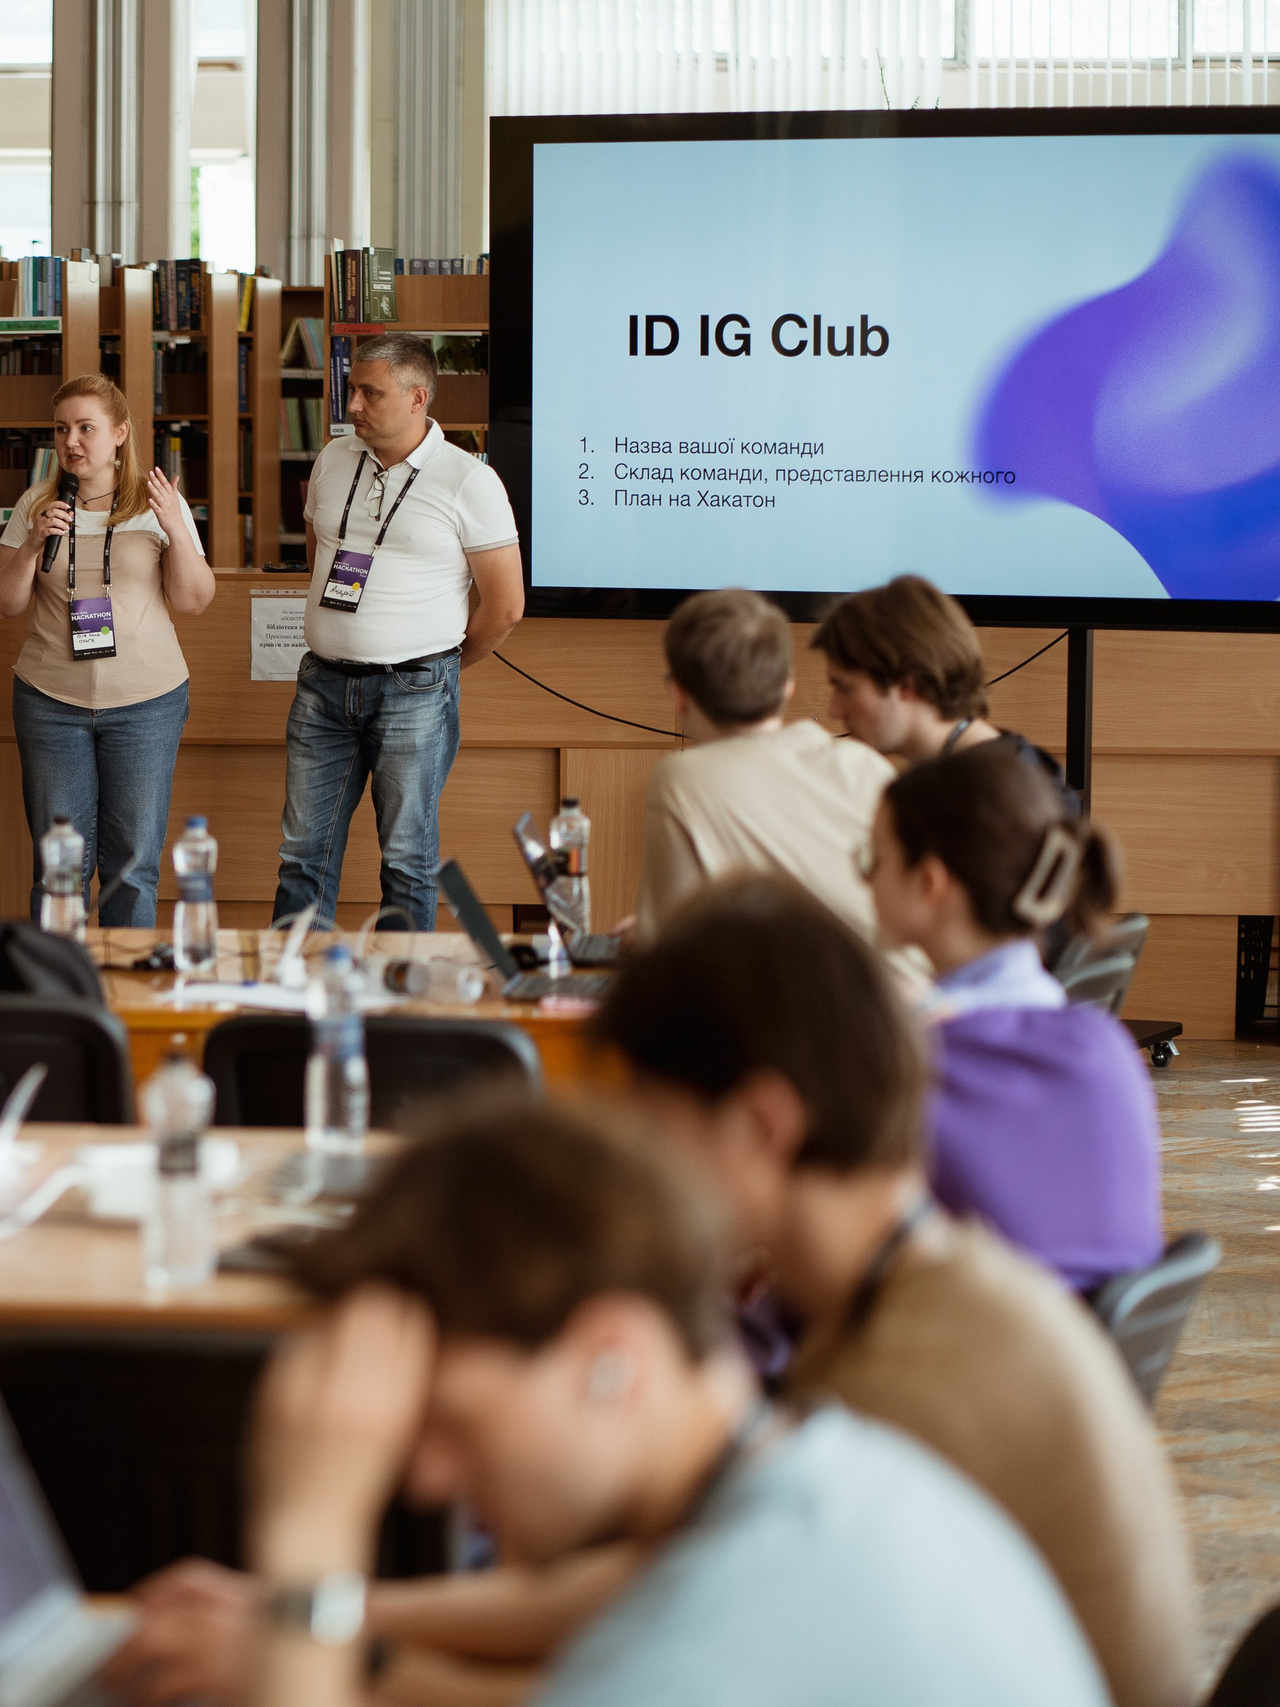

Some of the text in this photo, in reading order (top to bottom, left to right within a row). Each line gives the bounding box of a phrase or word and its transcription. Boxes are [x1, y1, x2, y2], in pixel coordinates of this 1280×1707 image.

[628, 313, 890, 358] ID IG Club
[579, 436, 824, 459] 1. Назва вашої команди
[578, 462, 1017, 486] 2. Склад команди, представлення кожного
[578, 488, 775, 508] 3. План на Хакатон
[334, 564, 368, 575] HACKATHON
[72, 612, 110, 620] HACKATHON
